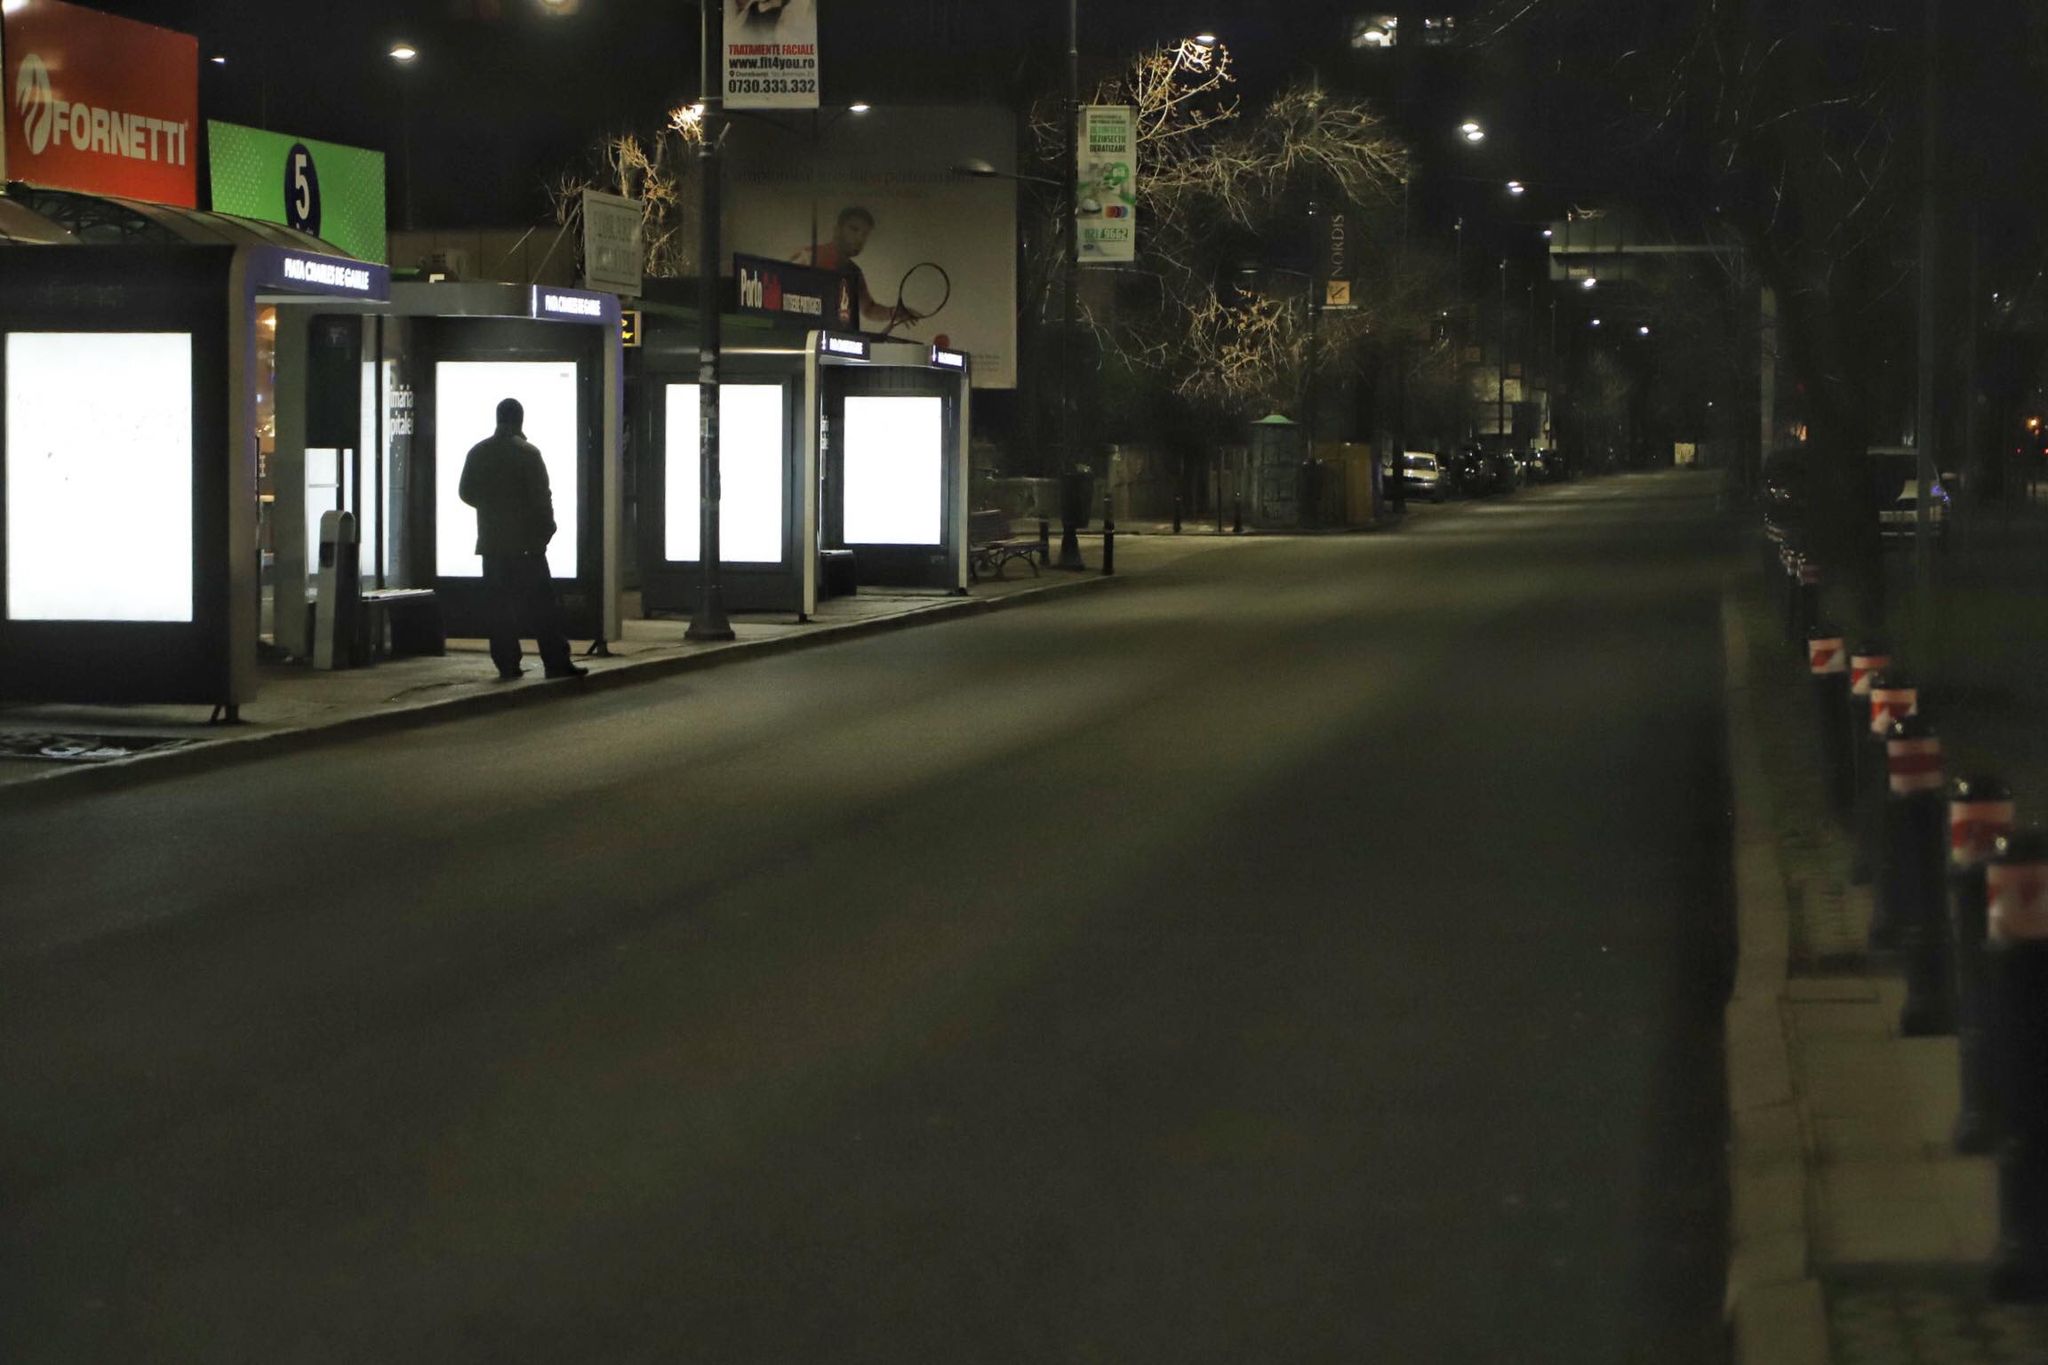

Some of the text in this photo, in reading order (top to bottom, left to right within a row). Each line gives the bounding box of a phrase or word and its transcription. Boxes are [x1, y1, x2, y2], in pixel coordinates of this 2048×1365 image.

[728, 44, 815, 55] TRATAMENTE FACIALE
[728, 56, 815, 70] www.fit4you.ro
[728, 79, 815, 93] 0730.333.332
[52, 100, 187, 166] FORNETTI
[295, 153, 310, 220] 5
[1330, 214, 1345, 277] NORDIS
